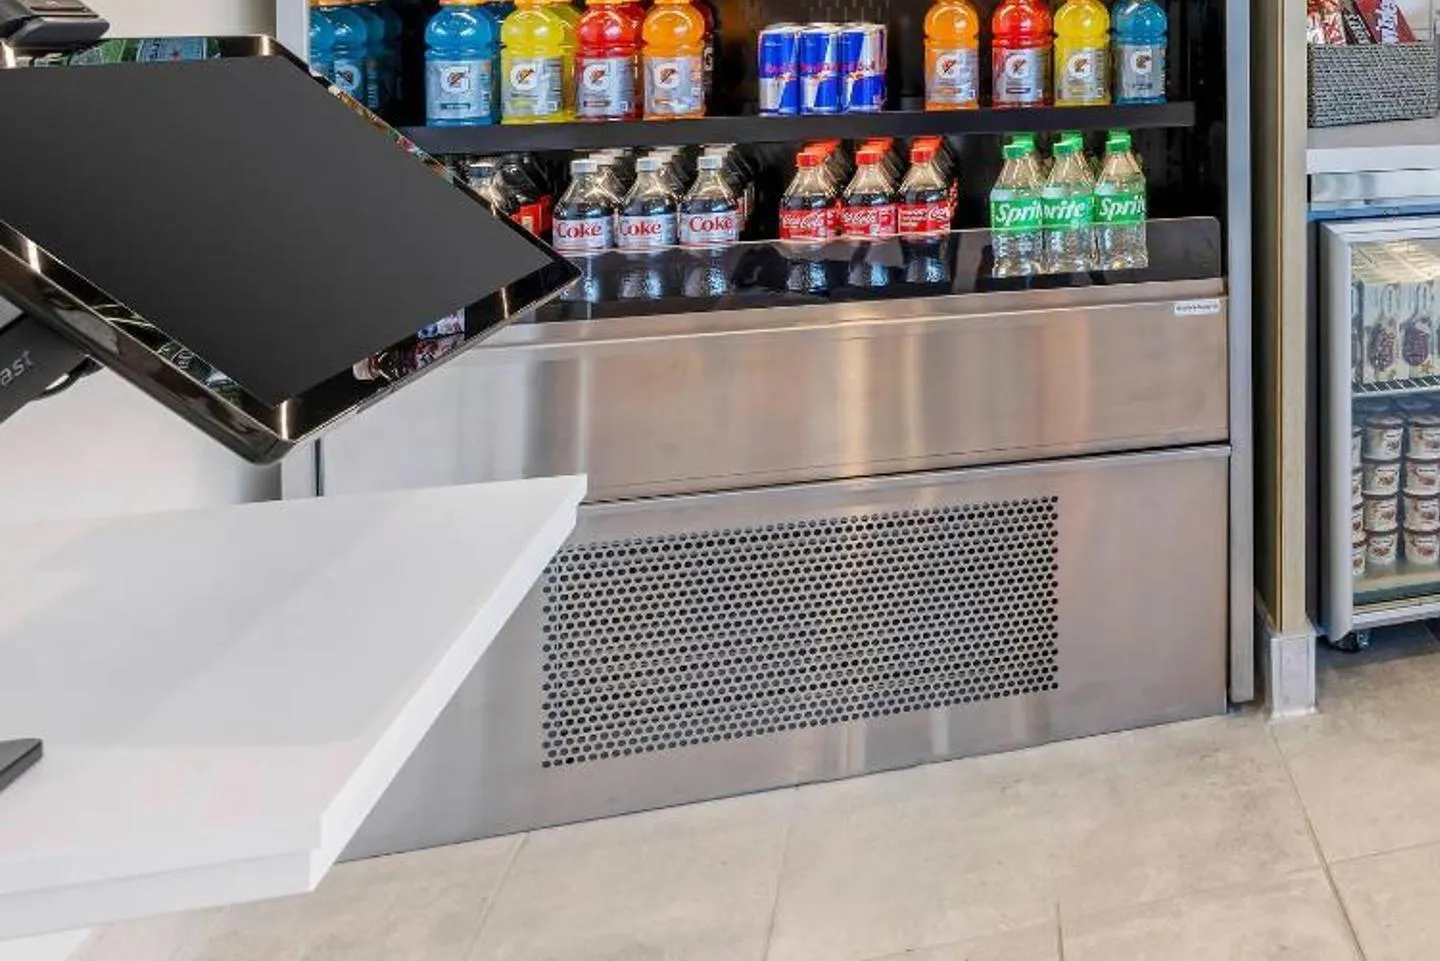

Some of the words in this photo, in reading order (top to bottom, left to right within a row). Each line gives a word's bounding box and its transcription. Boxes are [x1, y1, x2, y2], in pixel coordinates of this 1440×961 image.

[556, 221, 602, 239] Coke
[619, 219, 662, 236] Coke
[689, 215, 732, 233] Coke
